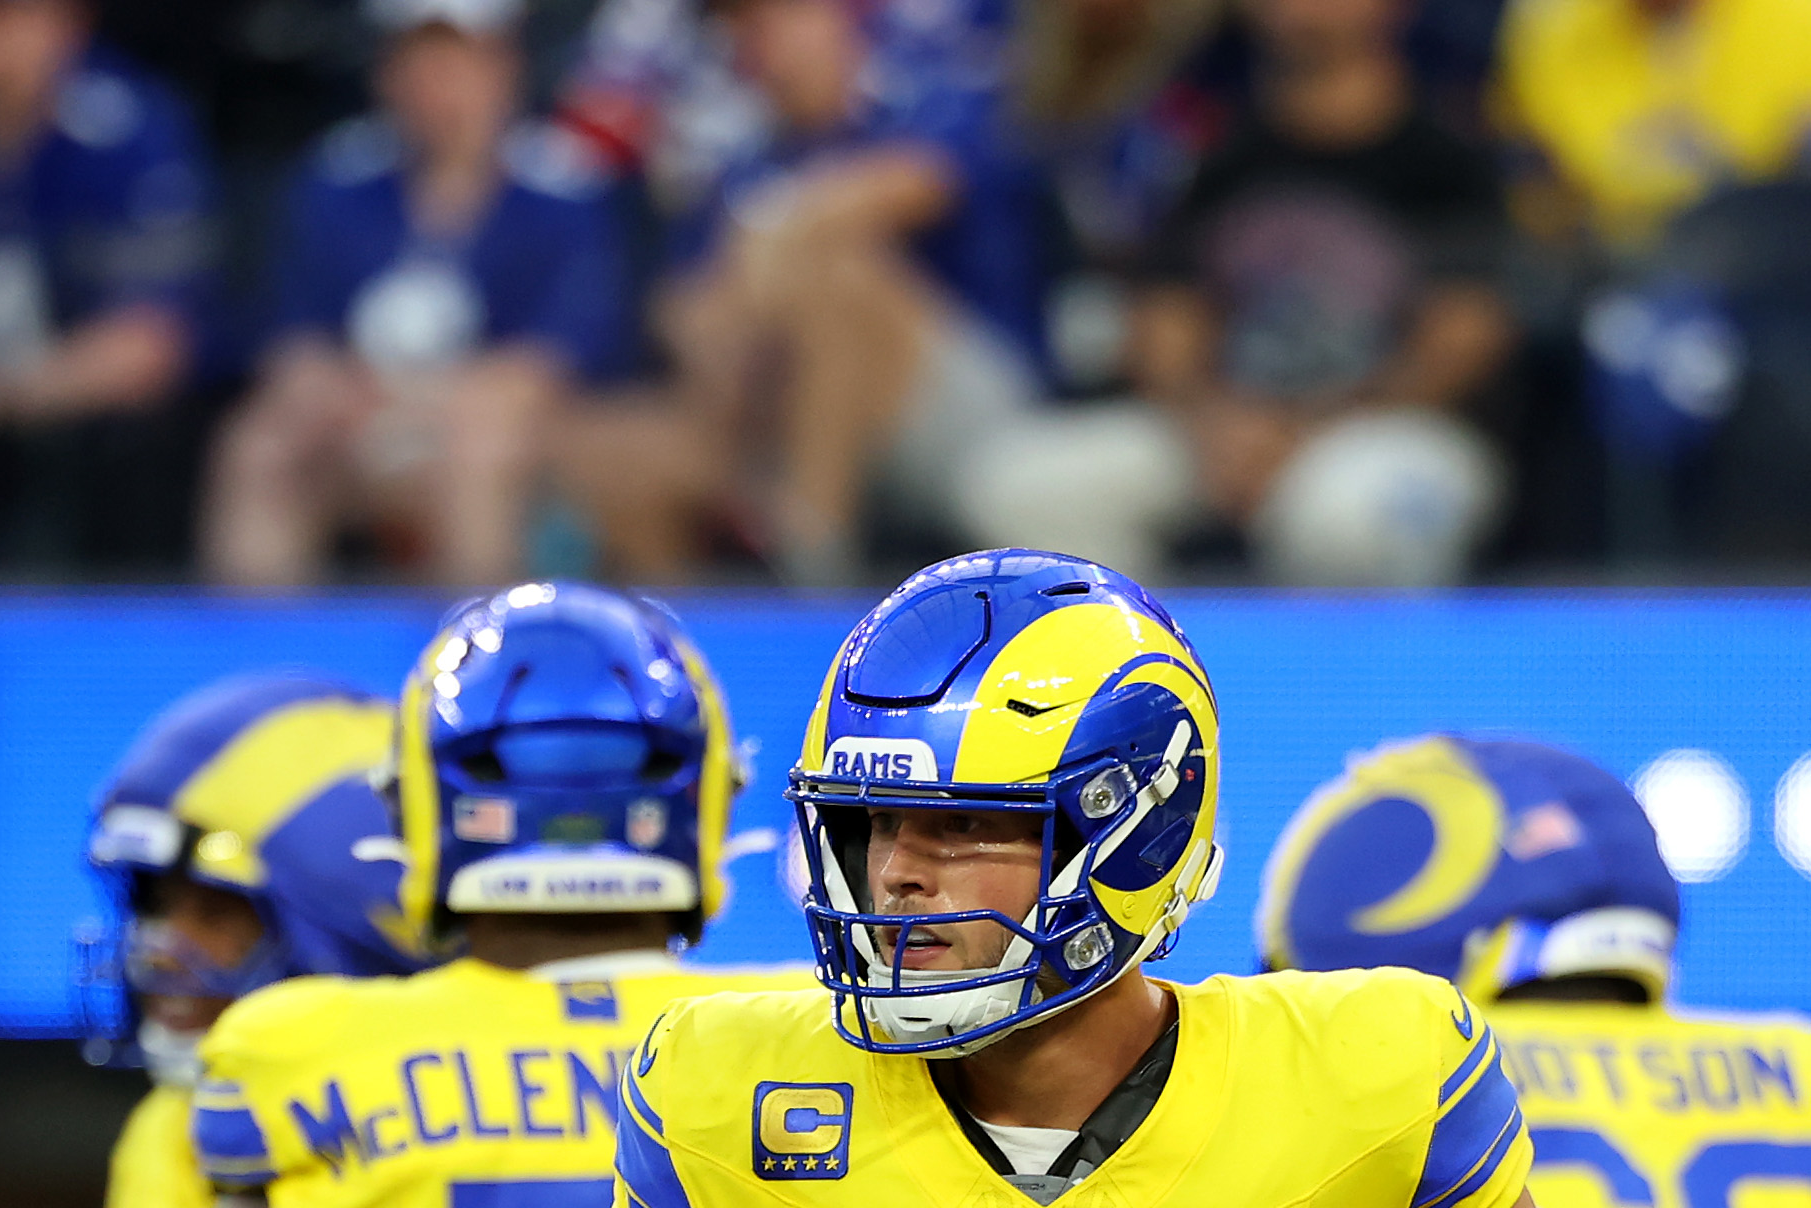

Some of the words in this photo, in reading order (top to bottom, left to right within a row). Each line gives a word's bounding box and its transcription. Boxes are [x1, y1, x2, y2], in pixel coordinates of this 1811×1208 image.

[832, 751, 913, 779] RAMS
[287, 1048, 634, 1176] McCLEN
[759, 1087, 845, 1154] C
